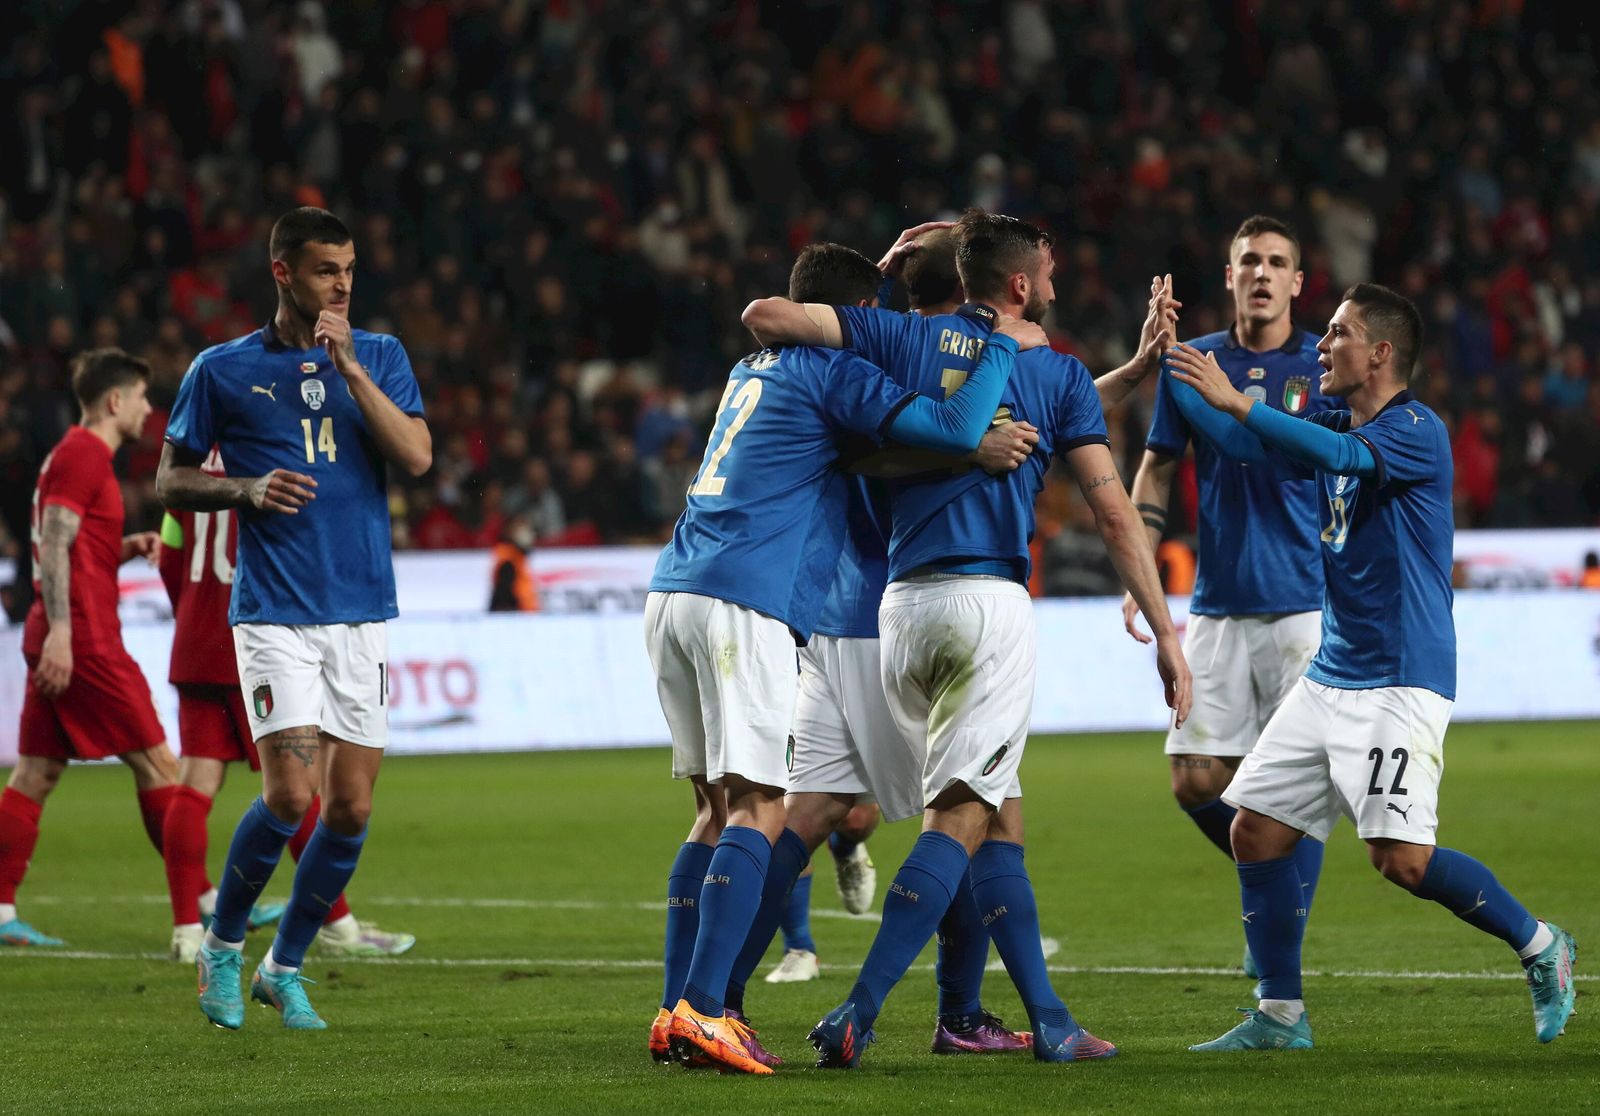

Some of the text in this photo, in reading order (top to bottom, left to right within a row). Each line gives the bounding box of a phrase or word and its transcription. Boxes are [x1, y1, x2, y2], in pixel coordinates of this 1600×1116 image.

[301, 417, 337, 463] 14
[1367, 747, 1409, 795] 22
[704, 874, 730, 885] ALIA
